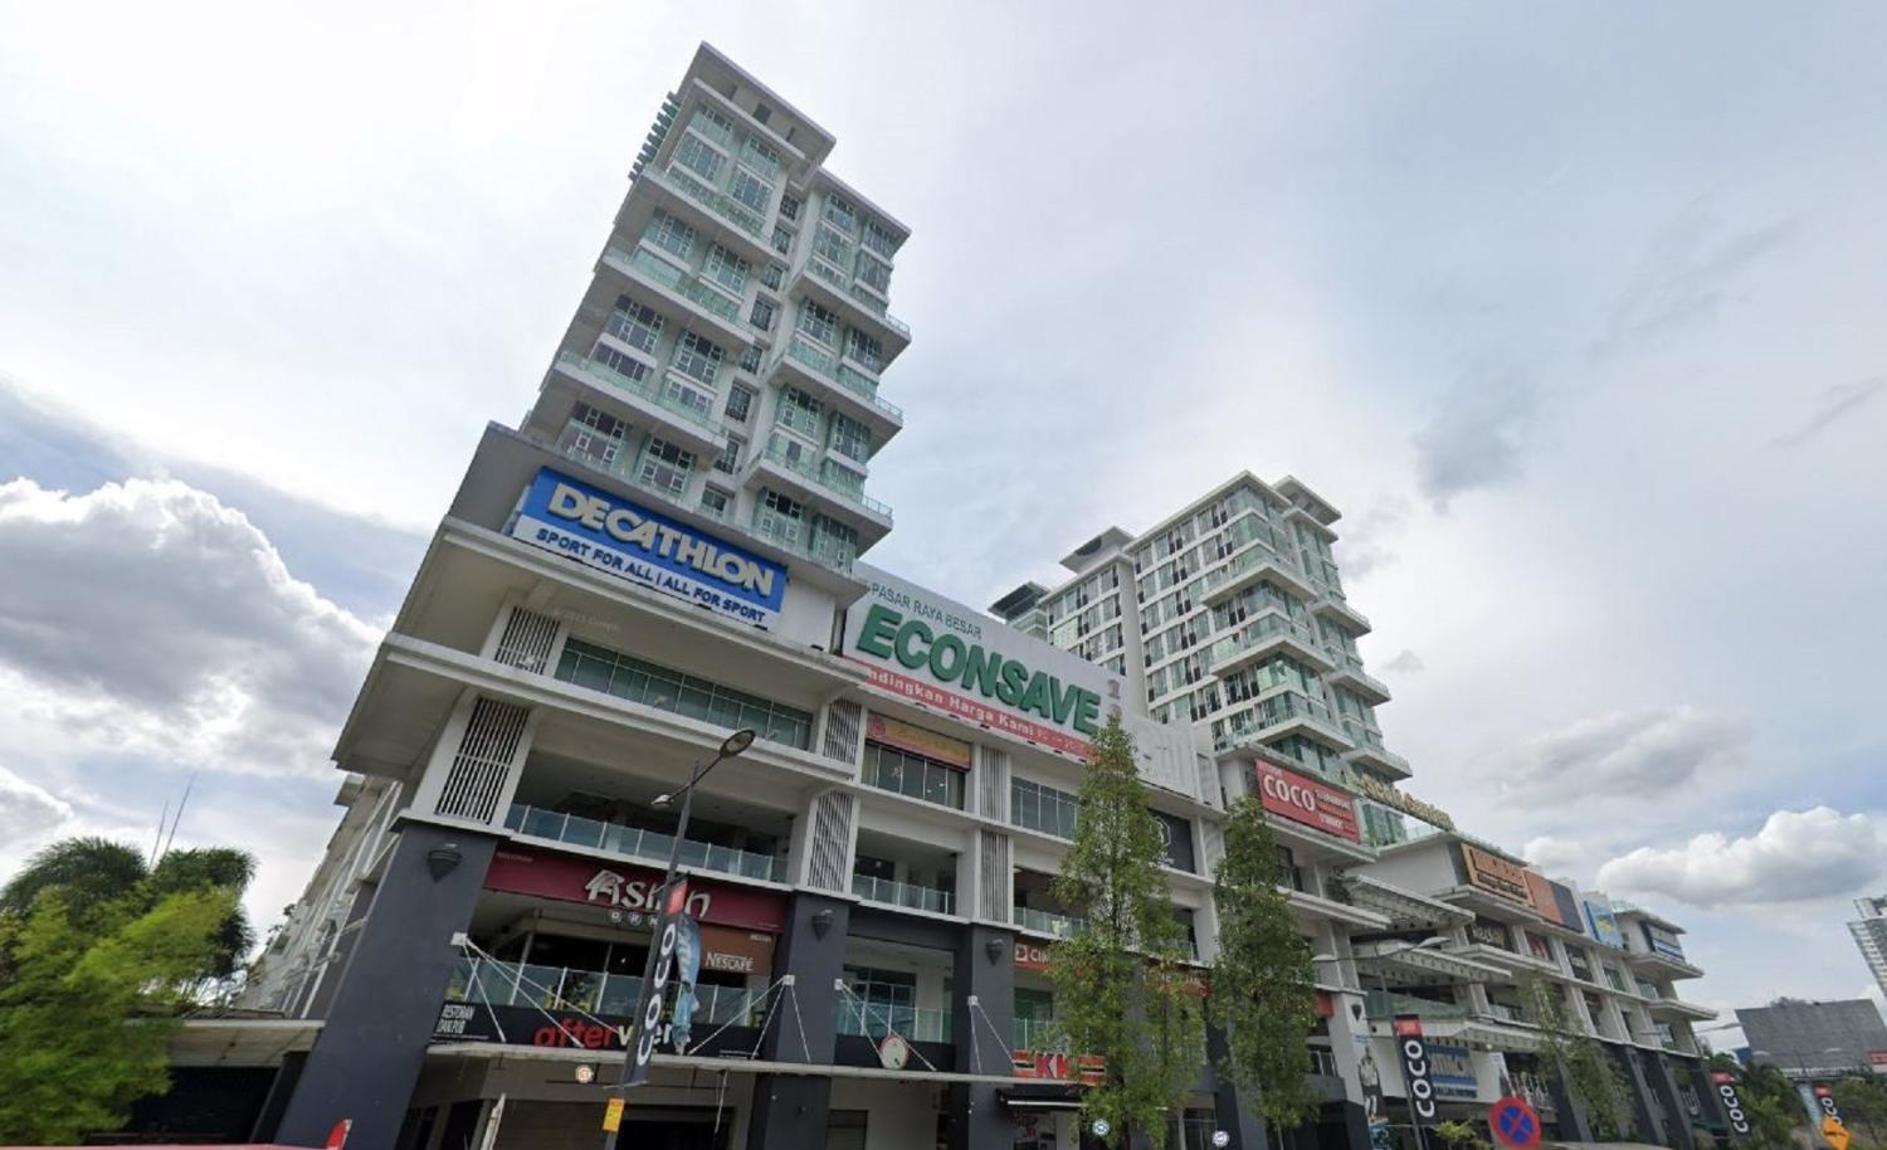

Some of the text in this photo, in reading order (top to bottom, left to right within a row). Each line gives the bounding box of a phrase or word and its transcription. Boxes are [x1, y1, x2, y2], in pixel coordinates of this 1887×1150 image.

[536, 527, 588, 559] SPORT
[591, 548, 624, 571] FOR
[625, 562, 654, 582] ALL
[663, 576, 691, 596] ALL
[693, 587, 721, 610] FOR
[722, 596, 767, 624] SPORT
[547, 482, 775, 598] DECATHLON
[870, 582, 982, 639] PASAR RAYA BESAR
[855, 603, 1101, 738] ECONSAVE
[949, 696, 995, 723] Harga
[999, 713, 1035, 738] Kami
[1263, 774, 1316, 812] COCO
[636, 922, 677, 1067] COCO
[1404, 1040, 1435, 1118] COCO
[1720, 1085, 1749, 1133] COCO
